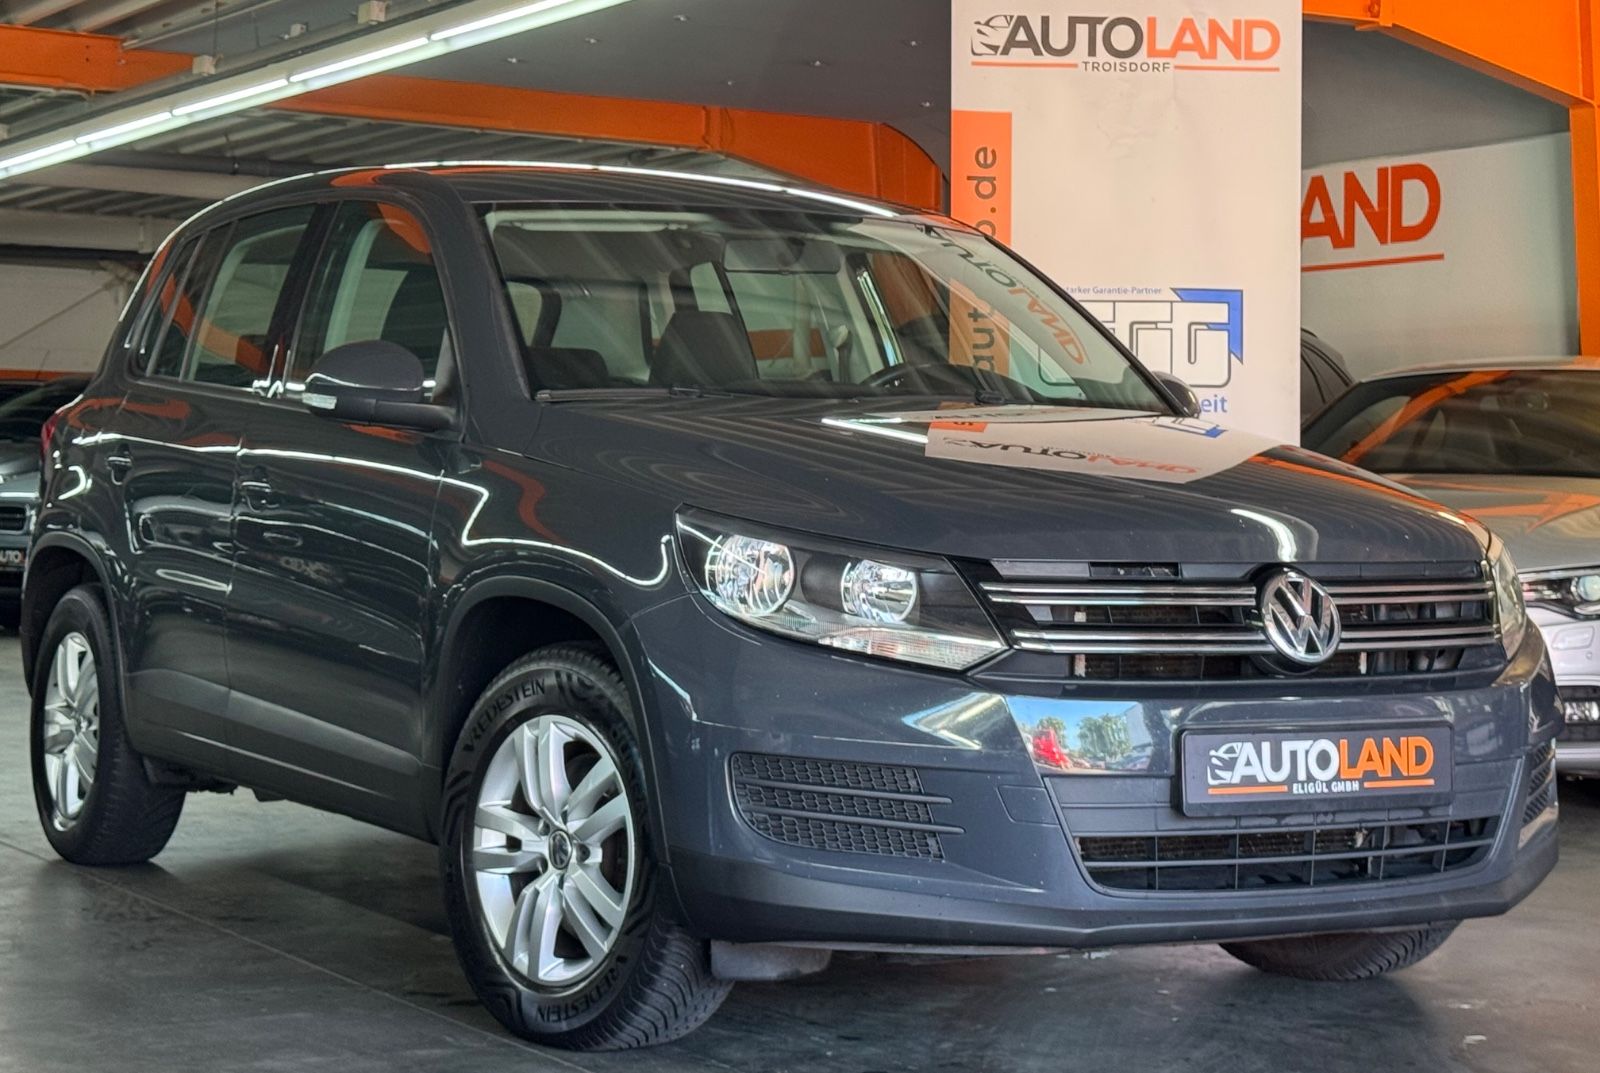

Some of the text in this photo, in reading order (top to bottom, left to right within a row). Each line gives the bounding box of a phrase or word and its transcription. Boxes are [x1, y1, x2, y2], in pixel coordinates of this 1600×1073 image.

[1000, 15, 1281, 61] AUTOLAND
[1082, 61, 1171, 73] TROISDORF
[1065, 286, 1163, 295] tarker Garantie-Partner
[462, 678, 546, 753] VREDESTEIN
[1230, 736, 1435, 785] AUTOLAND
[1292, 780, 1360, 794] ELIGÜL GMBH
